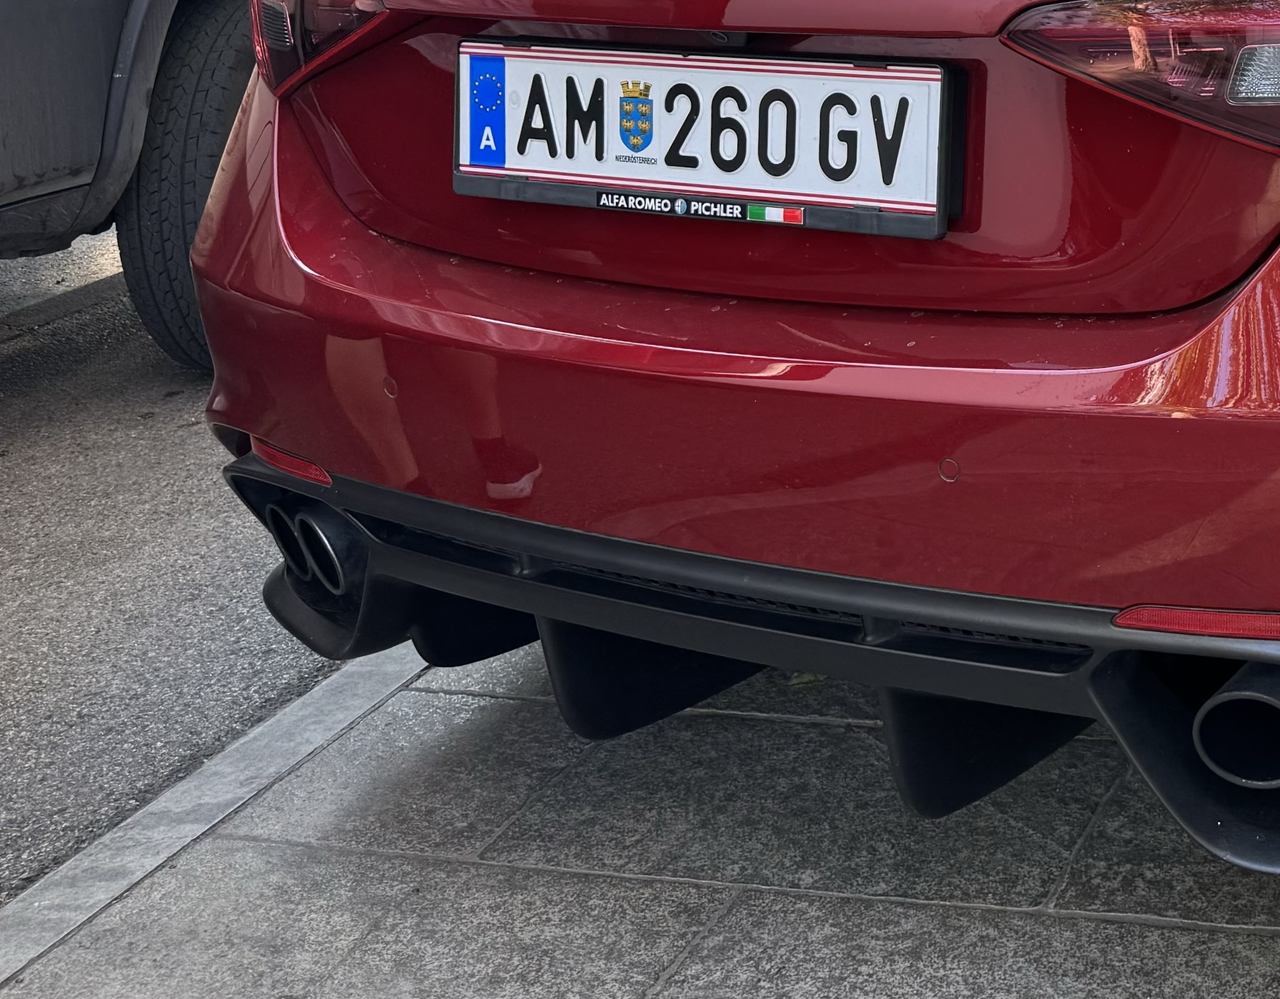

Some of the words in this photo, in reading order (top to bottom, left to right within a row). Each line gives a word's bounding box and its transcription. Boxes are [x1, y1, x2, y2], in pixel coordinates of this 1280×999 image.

[479, 127, 496, 151] A
[517, 73, 604, 162] AM
[664, 82, 797, 177] 260
[818, 92, 910, 187] GV
[690, 202, 742, 218] PICHLER
